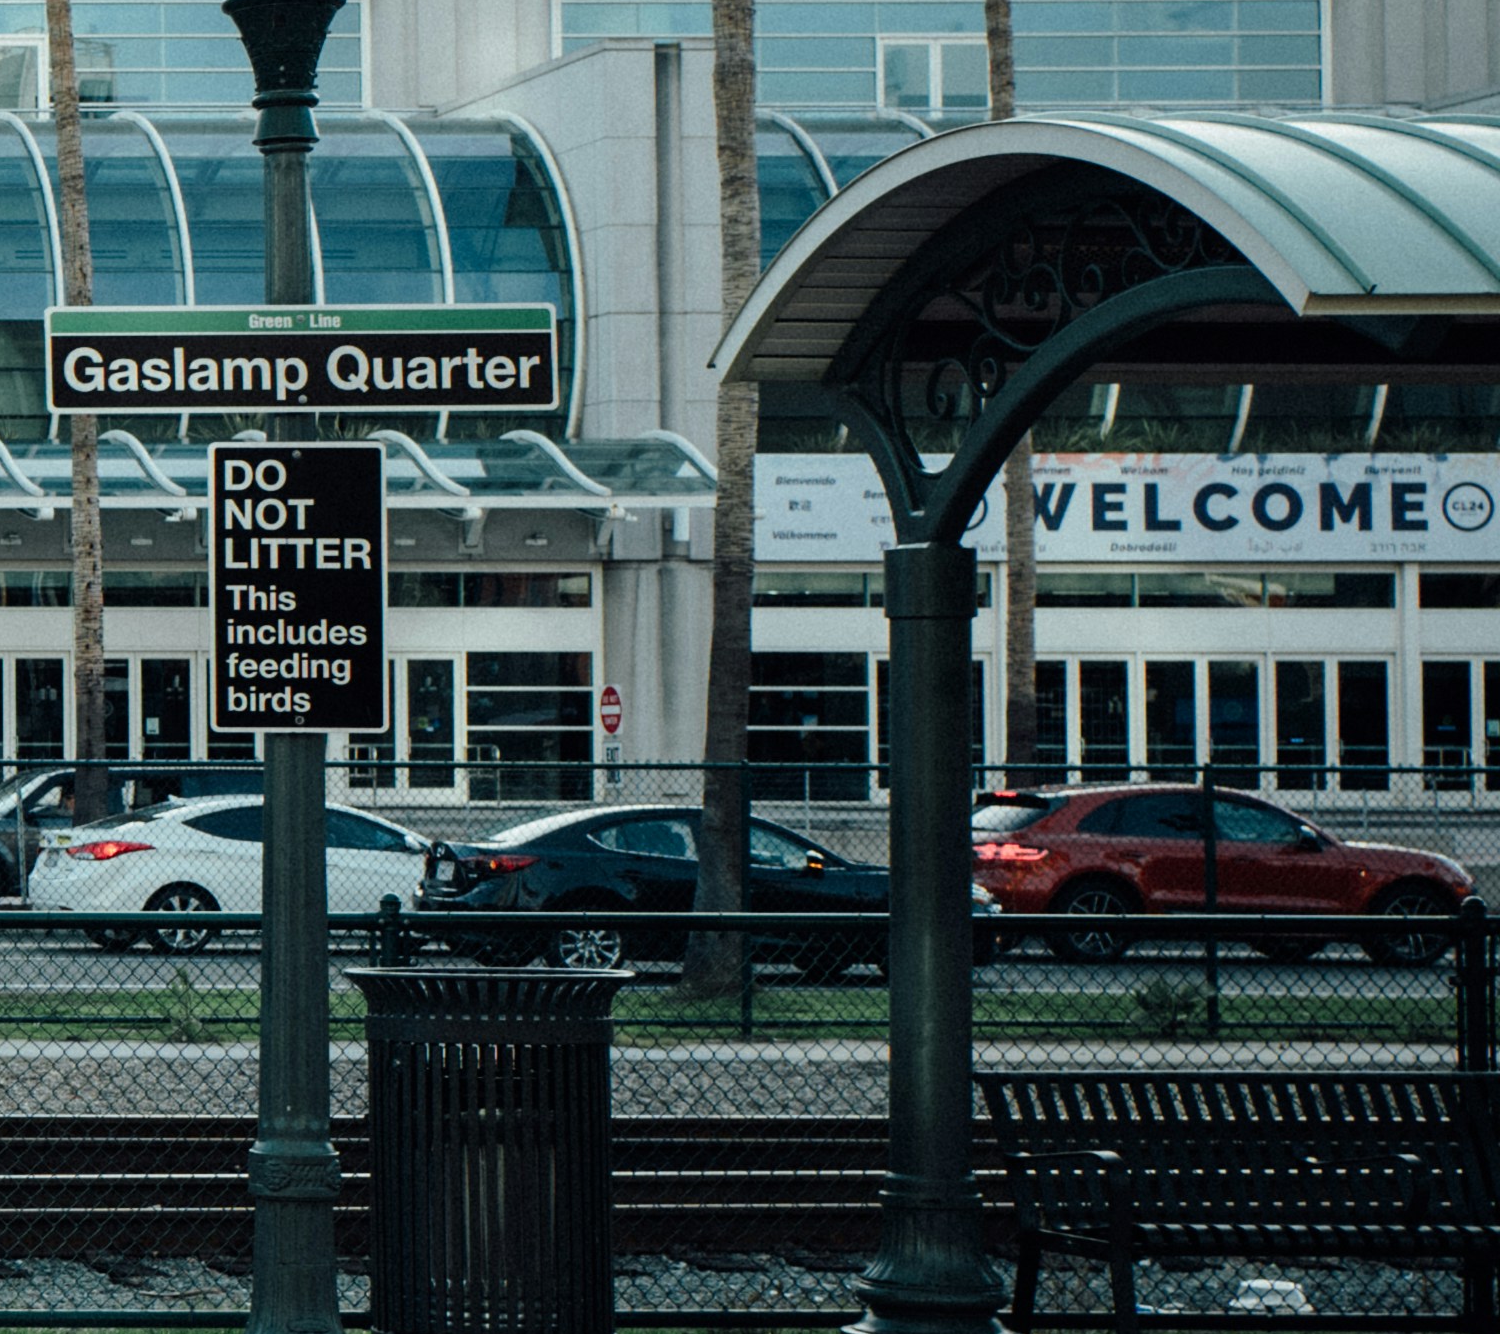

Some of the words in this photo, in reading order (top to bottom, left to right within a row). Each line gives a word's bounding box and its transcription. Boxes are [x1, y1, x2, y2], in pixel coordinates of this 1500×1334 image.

[248, 313, 292, 328] Green
[308, 313, 342, 328] Line
[63, 346, 309, 402] Gaslamp
[326, 344, 541, 393] Quarter
[223, 459, 287, 492] DO
[775, 475, 837, 487] Bienvenido
[223, 498, 315, 531] NOT
[1002, 482, 1429, 533] WELCOME
[224, 537, 372, 571] LITTER
[226, 584, 296, 612] This
[226, 617, 368, 646] includes
[226, 652, 353, 687] feeding
[227, 685, 312, 714] birds
